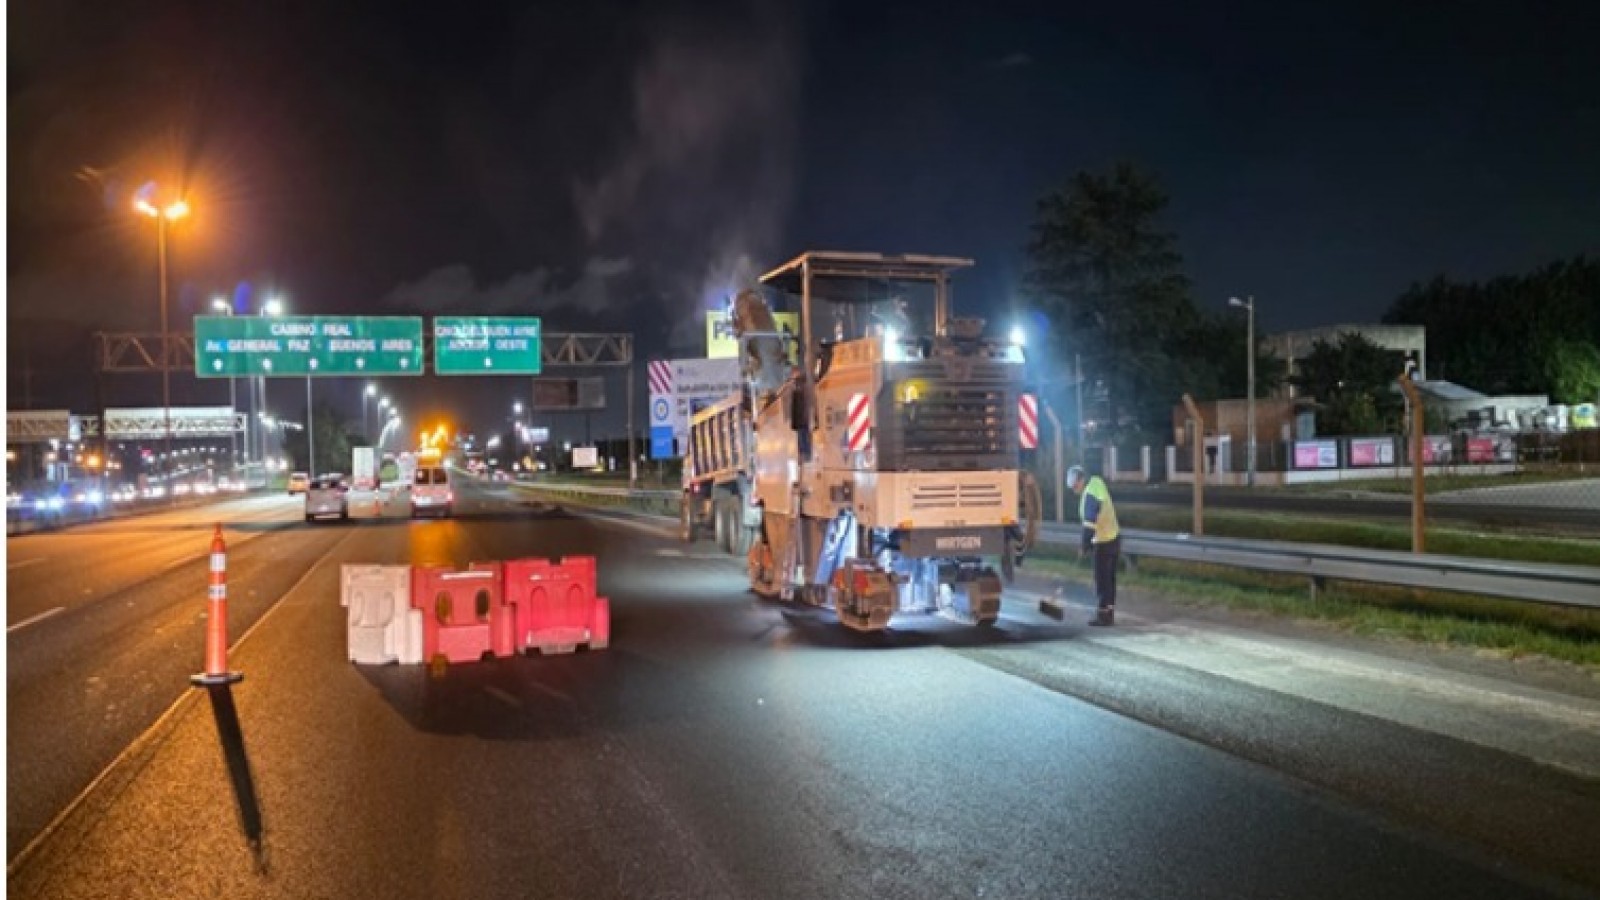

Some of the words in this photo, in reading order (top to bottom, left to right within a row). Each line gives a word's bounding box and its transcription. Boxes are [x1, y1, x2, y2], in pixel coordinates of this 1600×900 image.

[323, 323, 352, 335] REAL
[227, 339, 281, 351] GENERAL
[288, 339, 310, 351] PAZ
[329, 339, 375, 351] BUENOS
[382, 339, 412, 351] AIRES
[494, 339, 528, 350] OESTE
